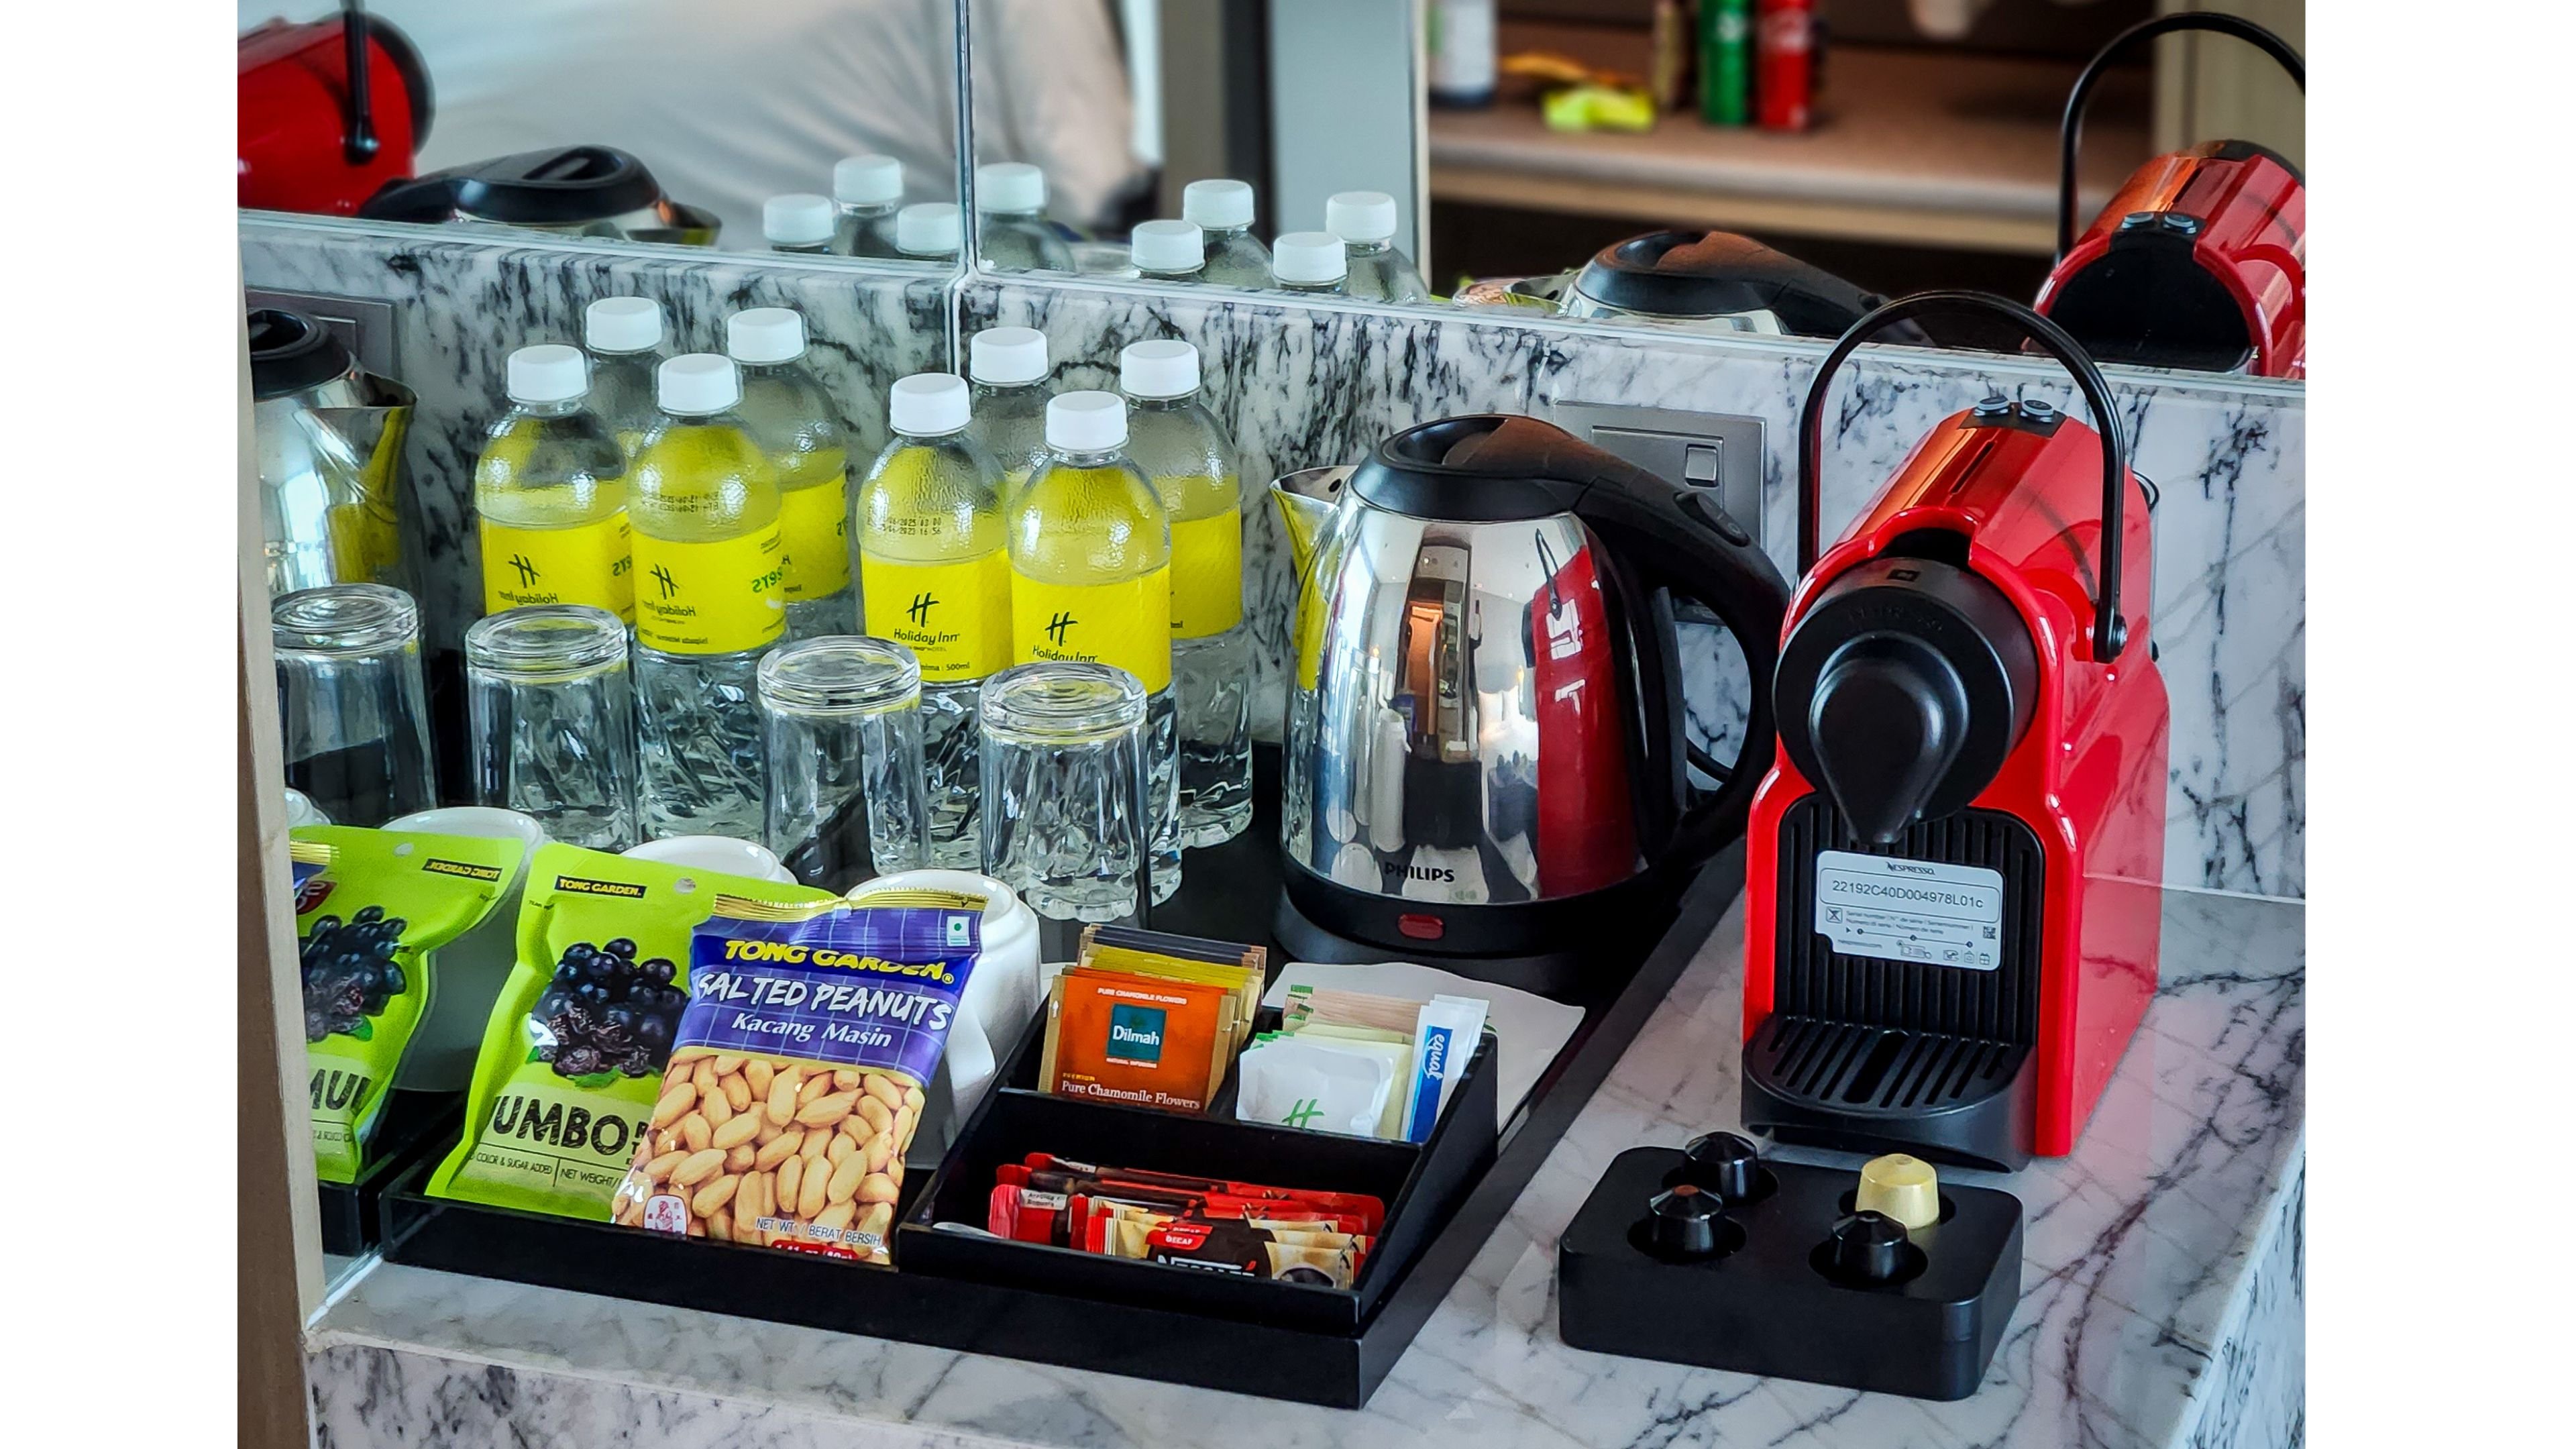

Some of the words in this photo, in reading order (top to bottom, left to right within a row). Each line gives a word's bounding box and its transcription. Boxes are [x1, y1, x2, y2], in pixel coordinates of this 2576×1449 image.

[894, 629, 936, 645] Holiday
[938, 631, 958, 643] Inn
[946, 661, 970, 671] 500ml
[1384, 861, 1455, 883] PHILIPS
[559, 879, 590, 891] TONG
[592, 883, 640, 896] GARDEN
[1832, 879, 1984, 908] 22192C40D004978L01c
[725, 939, 807, 964] TONG
[698, 972, 808, 1008] SALTED
[810, 982, 953, 1031] PEANUTS
[1097, 987, 1115, 996] PURE
[731, 1012, 816, 1043] Kacang
[820, 1024, 893, 1049] Masin
[1112, 1025, 1161, 1046] Dilmah
[1423, 1033, 1445, 1081] equal
[1061, 1080, 1085, 1093] Pure
[1087, 1083, 1153, 1104] Chamomile
[1155, 1092, 1201, 1110] Flowers
[494, 1095, 629, 1156] UMBO
[507, 1158, 529, 1170] SUGAR
[561, 1168, 577, 1179] NET
[757, 1218, 775, 1230] NET
[809, 1226, 843, 1239] BERAT
[845, 1232, 882, 1246] BERSIH
[1165, 1234, 1194, 1246] DECAF
